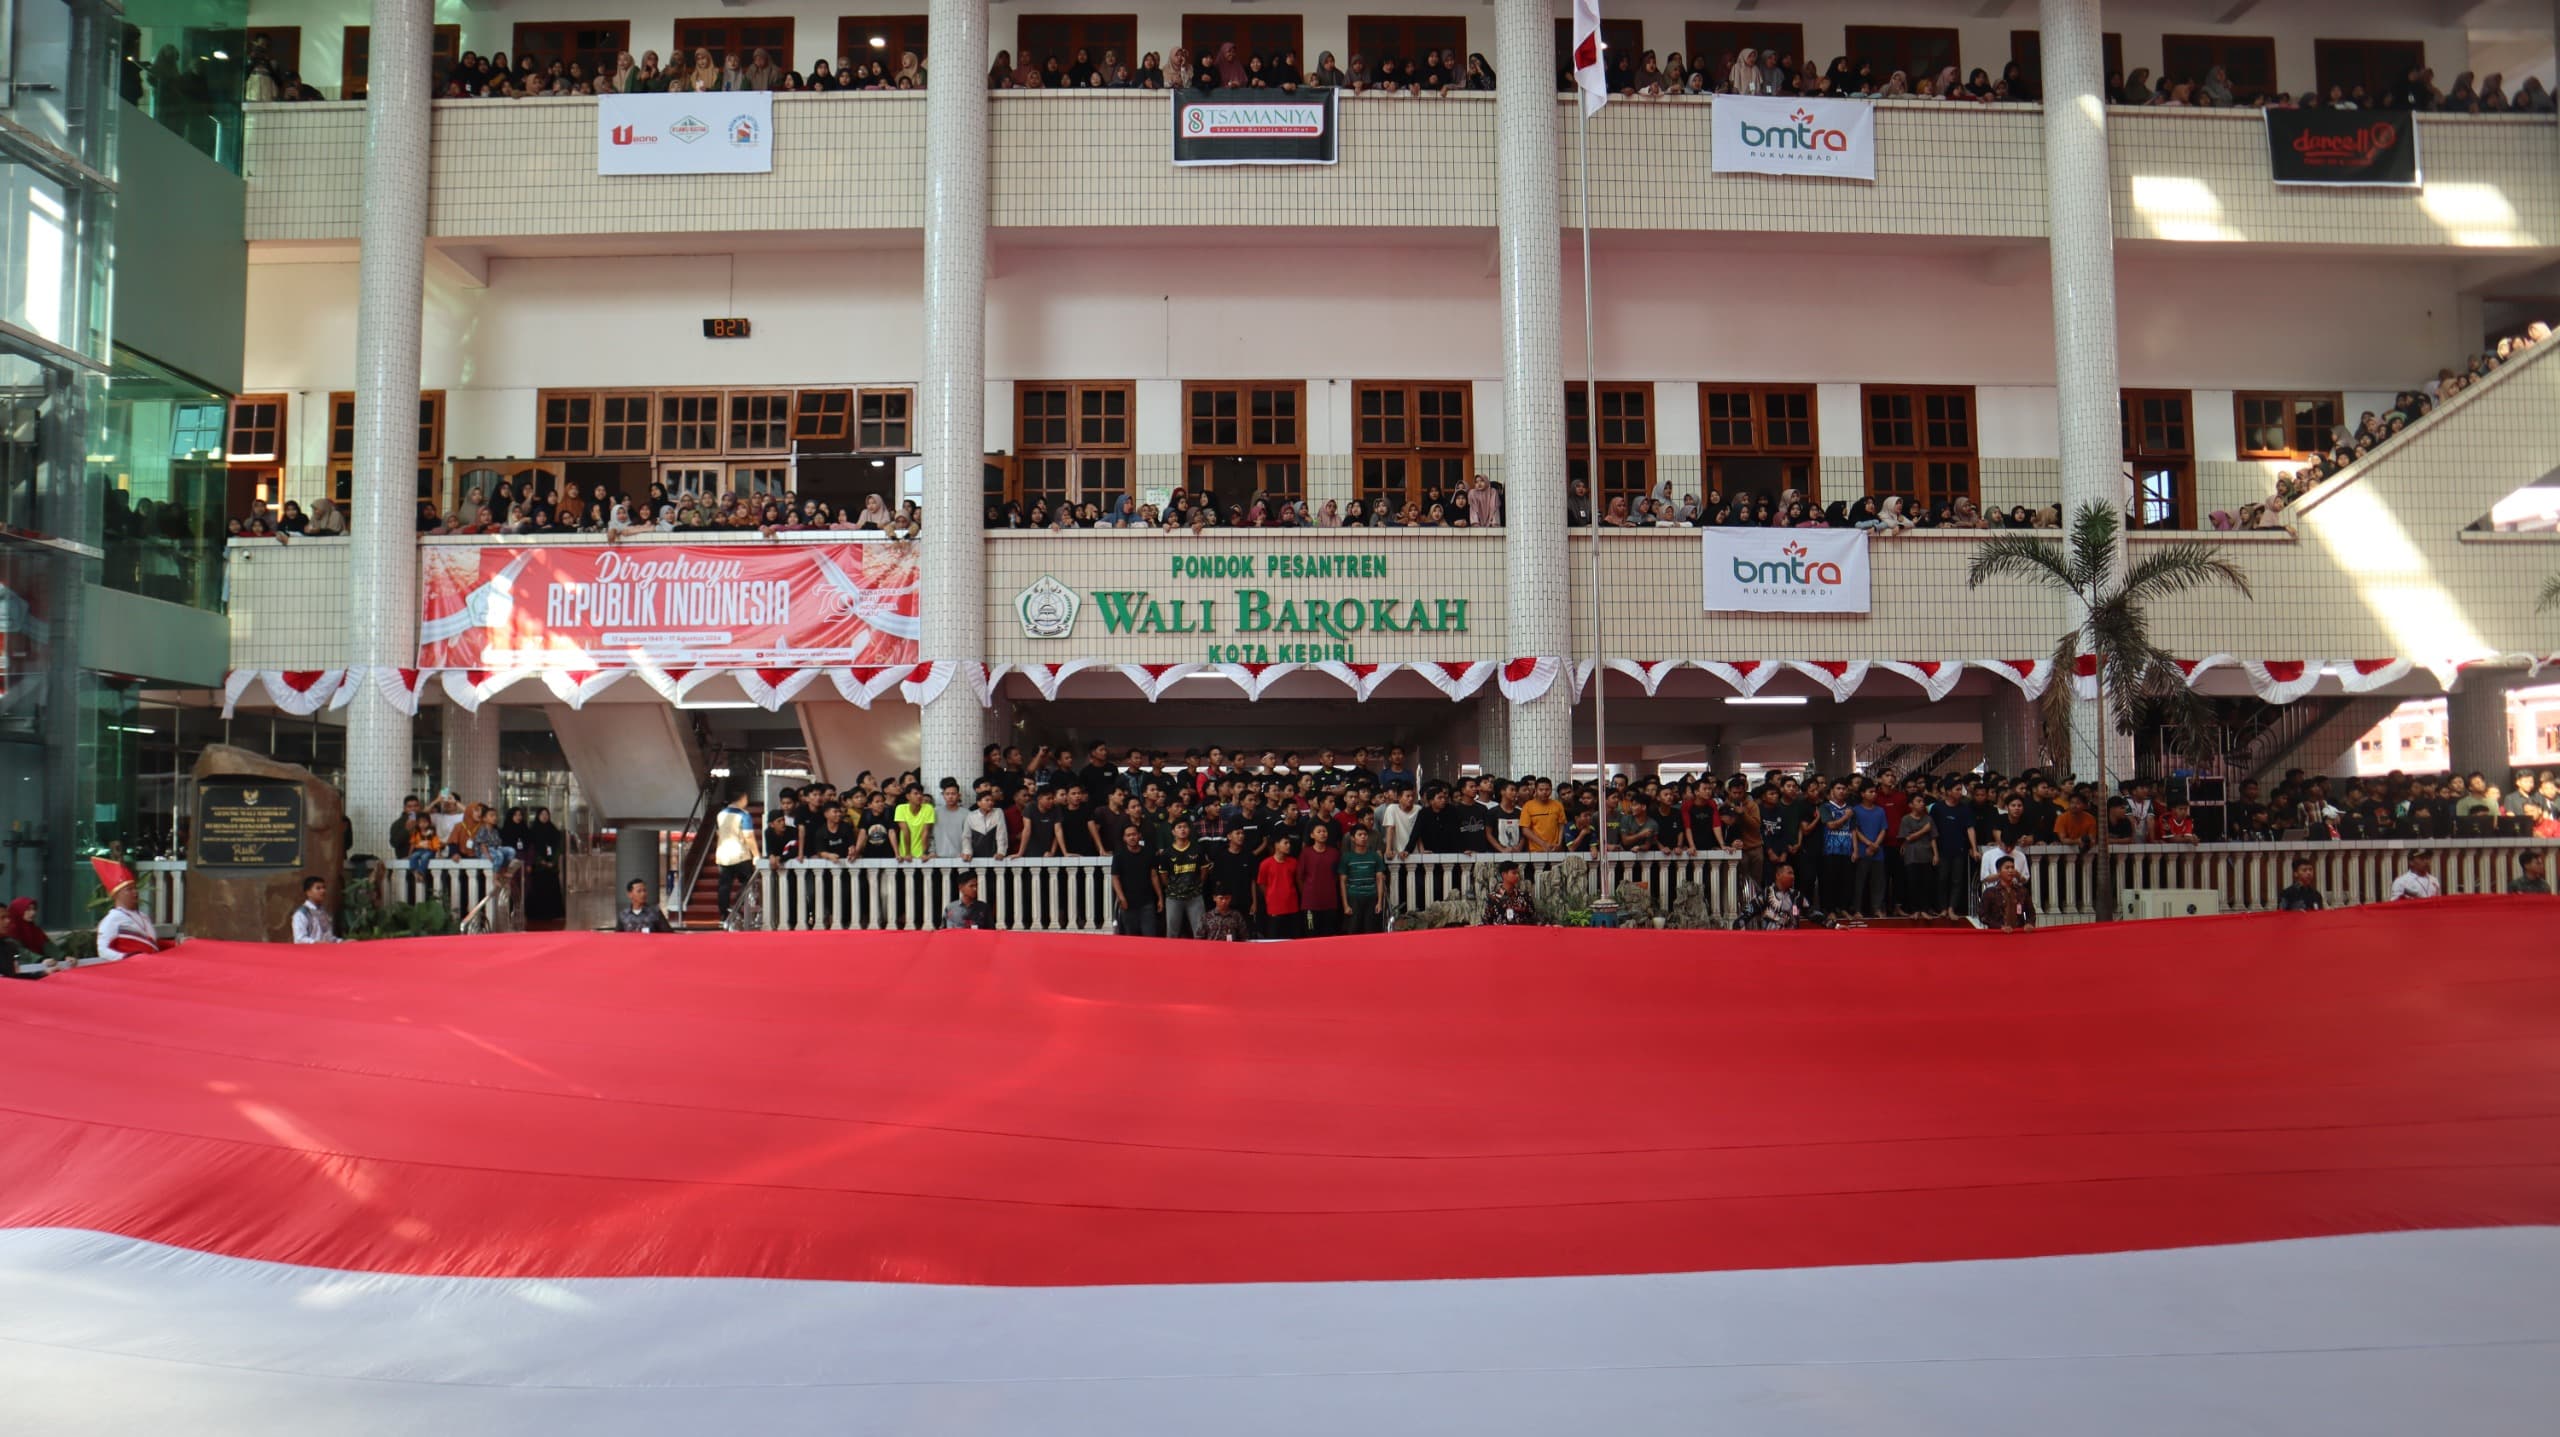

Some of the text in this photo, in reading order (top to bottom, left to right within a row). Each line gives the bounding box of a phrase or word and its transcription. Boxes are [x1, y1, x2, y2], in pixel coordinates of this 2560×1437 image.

[1206, 109, 1317, 124] TSAMANIYA
[1741, 121, 1847, 152] bmtra
[595, 551, 744, 590] Dirgahayu
[1172, 555, 1387, 578] PONDOK PESANTREN
[1733, 556, 1841, 584] bmtra
[547, 580, 790, 627] REPUBLIK INDONESIA
[1091, 589, 1468, 641] WALI BAROKAH
[1208, 644, 1354, 663] KOTA KEDIRI
